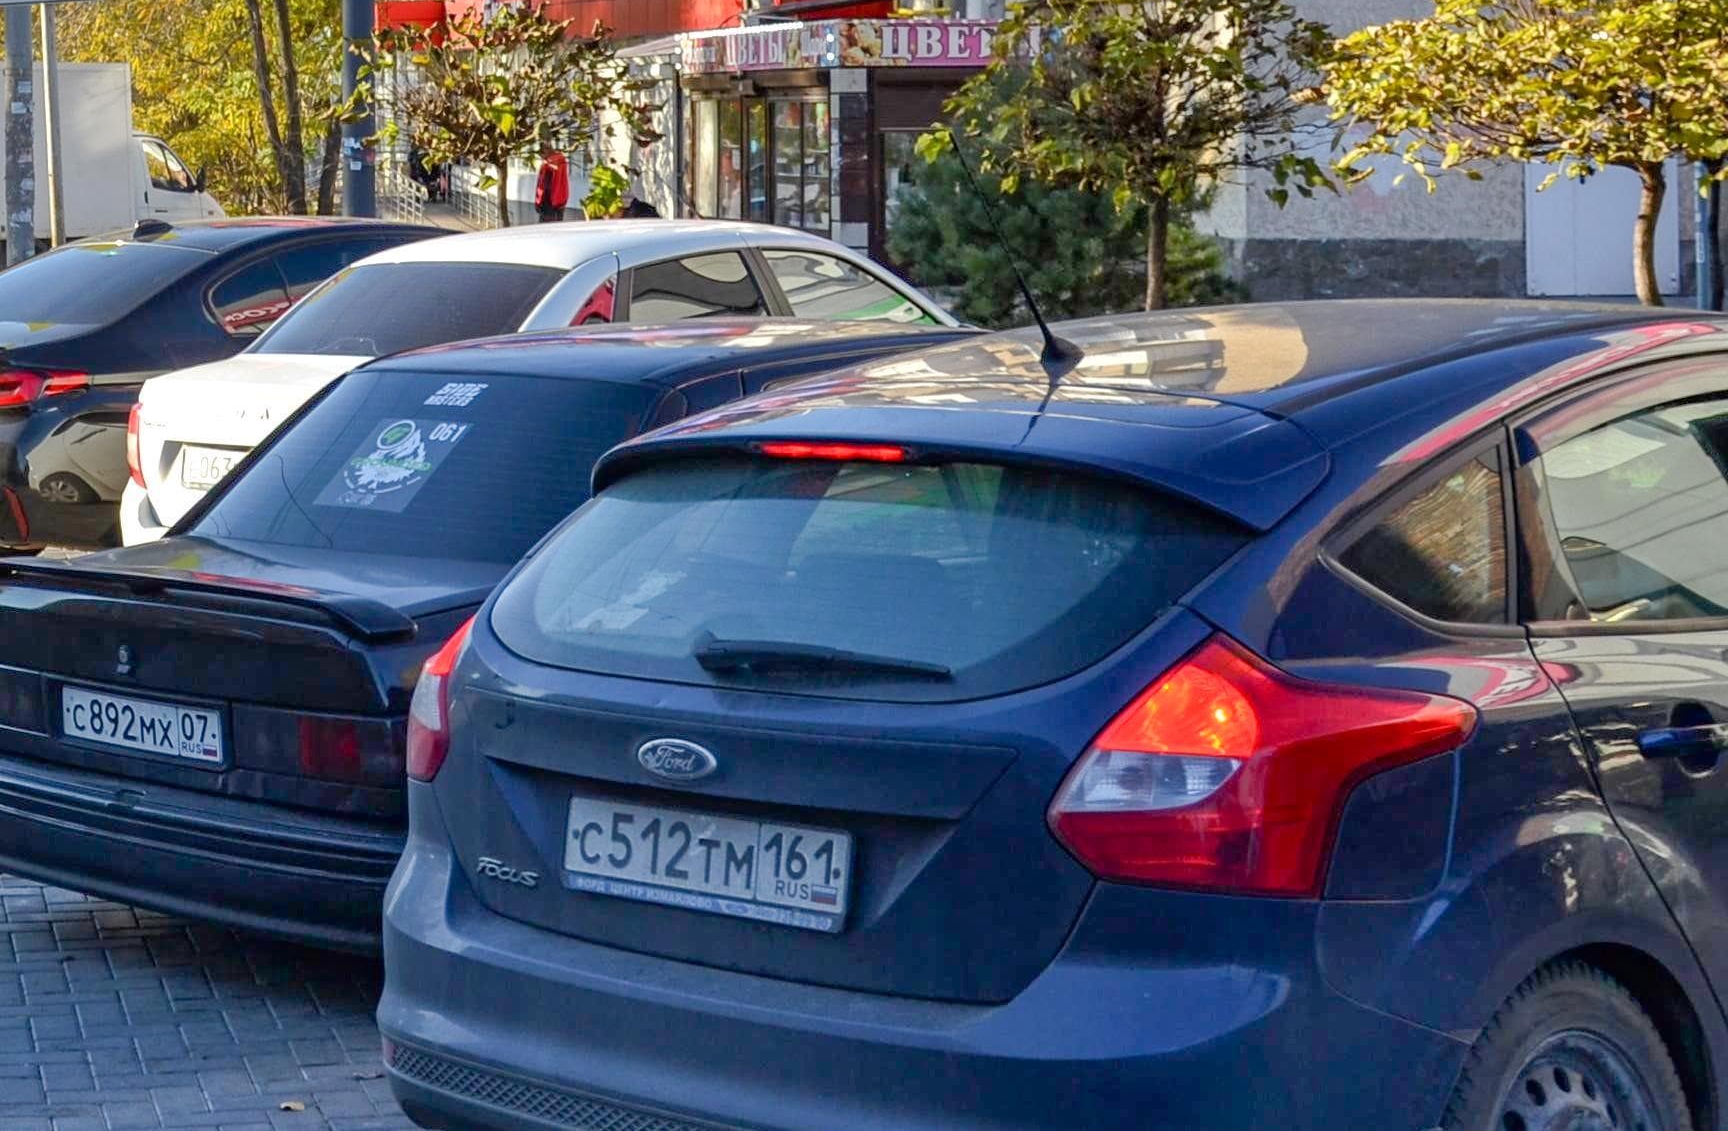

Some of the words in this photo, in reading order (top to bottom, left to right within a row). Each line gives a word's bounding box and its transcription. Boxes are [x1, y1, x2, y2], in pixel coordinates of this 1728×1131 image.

[725, 30, 785, 66] ЦВЕТЫ
[429, 422, 467, 443] 061
[72, 699, 174, 749] С892МХ
[181, 712, 208, 741] 07
[181, 741, 203, 755] RUS
[654, 744, 697, 773] Ford
[579, 813, 756, 890] С512ТМ
[764, 832, 835, 885] 161
[774, 880, 809, 901] RUS
